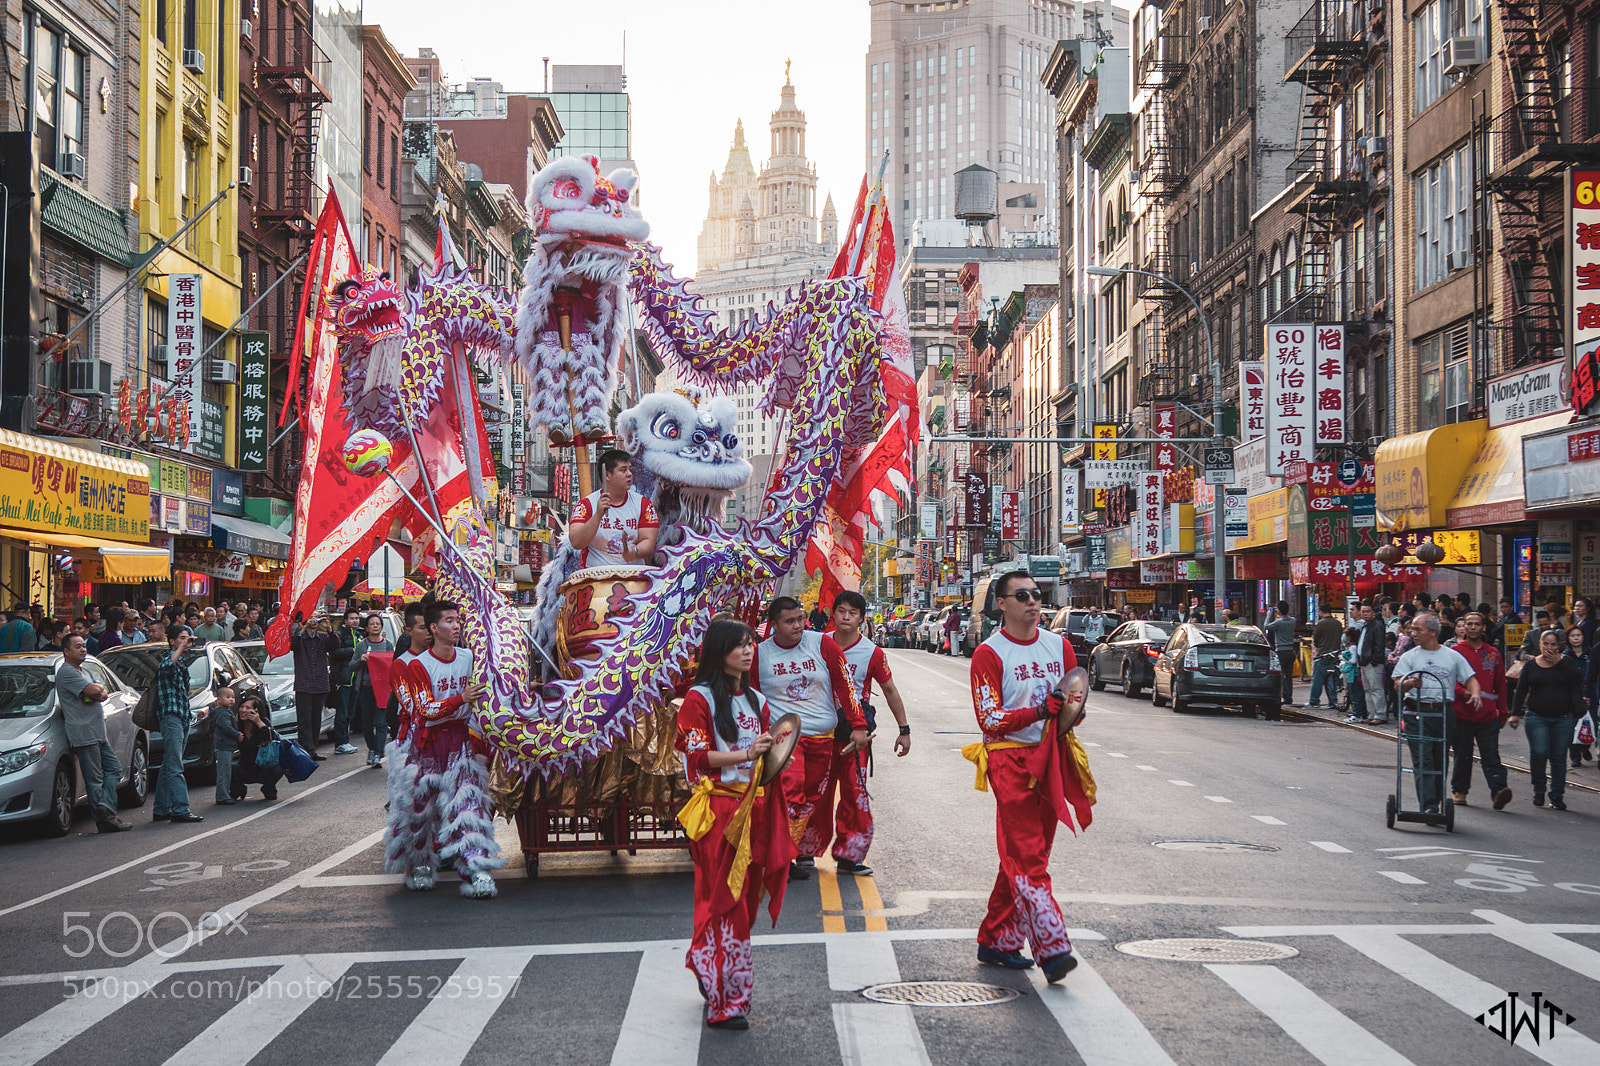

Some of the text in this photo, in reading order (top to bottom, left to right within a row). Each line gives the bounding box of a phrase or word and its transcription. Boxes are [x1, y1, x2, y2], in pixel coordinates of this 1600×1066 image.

[1576, 181, 1600, 206] 6
[243, 341, 266, 465] 欣榕服務中心
[1491, 372, 1551, 403] MoneyGram
[1310, 464, 1375, 485] 好駕
[79, 475, 126, 515] 福州小吃店
[1313, 498, 1331, 509] 62
[1145, 474, 1160, 555] 興旺旺商場
